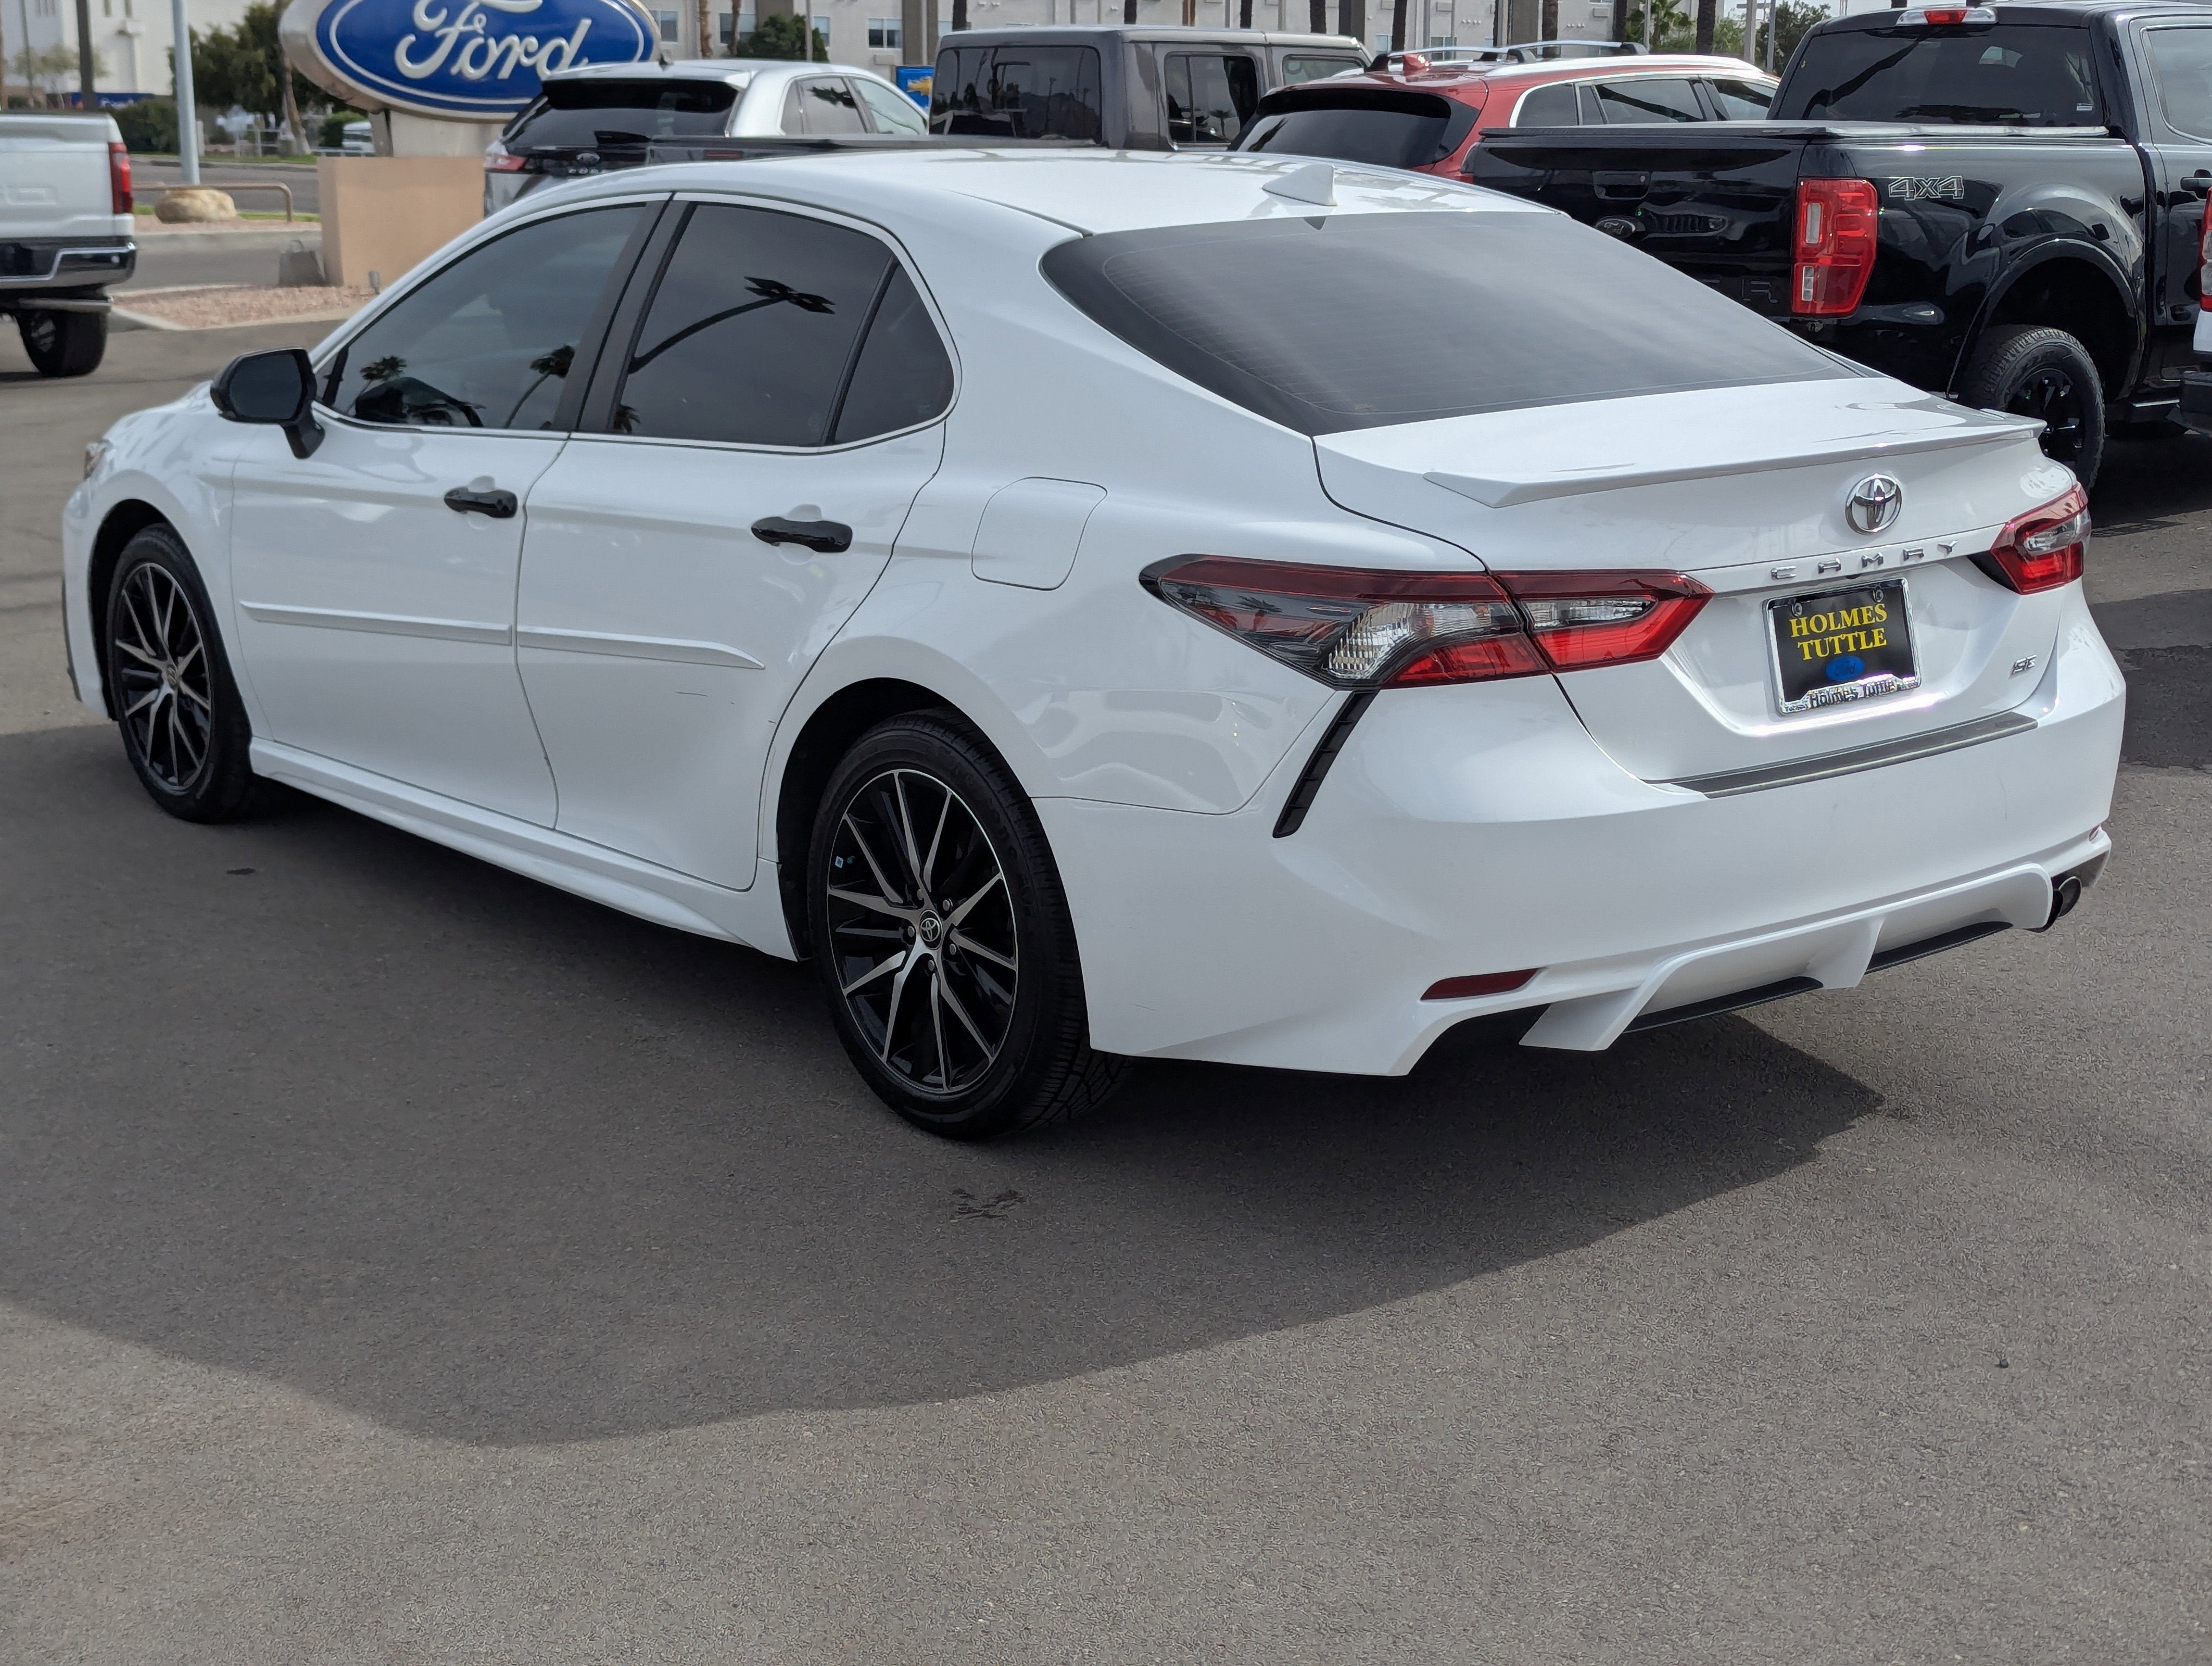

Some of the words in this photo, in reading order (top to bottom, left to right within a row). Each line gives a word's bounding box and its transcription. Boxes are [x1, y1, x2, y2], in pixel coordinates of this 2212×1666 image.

[395, 0, 592, 80] Ford
[1771, 540, 1958, 579] CAMRY
[1789, 604, 1887, 637] HOLMES
[1797, 628, 1887, 660] TUTTLE
[2011, 654, 2037, 675] SE
